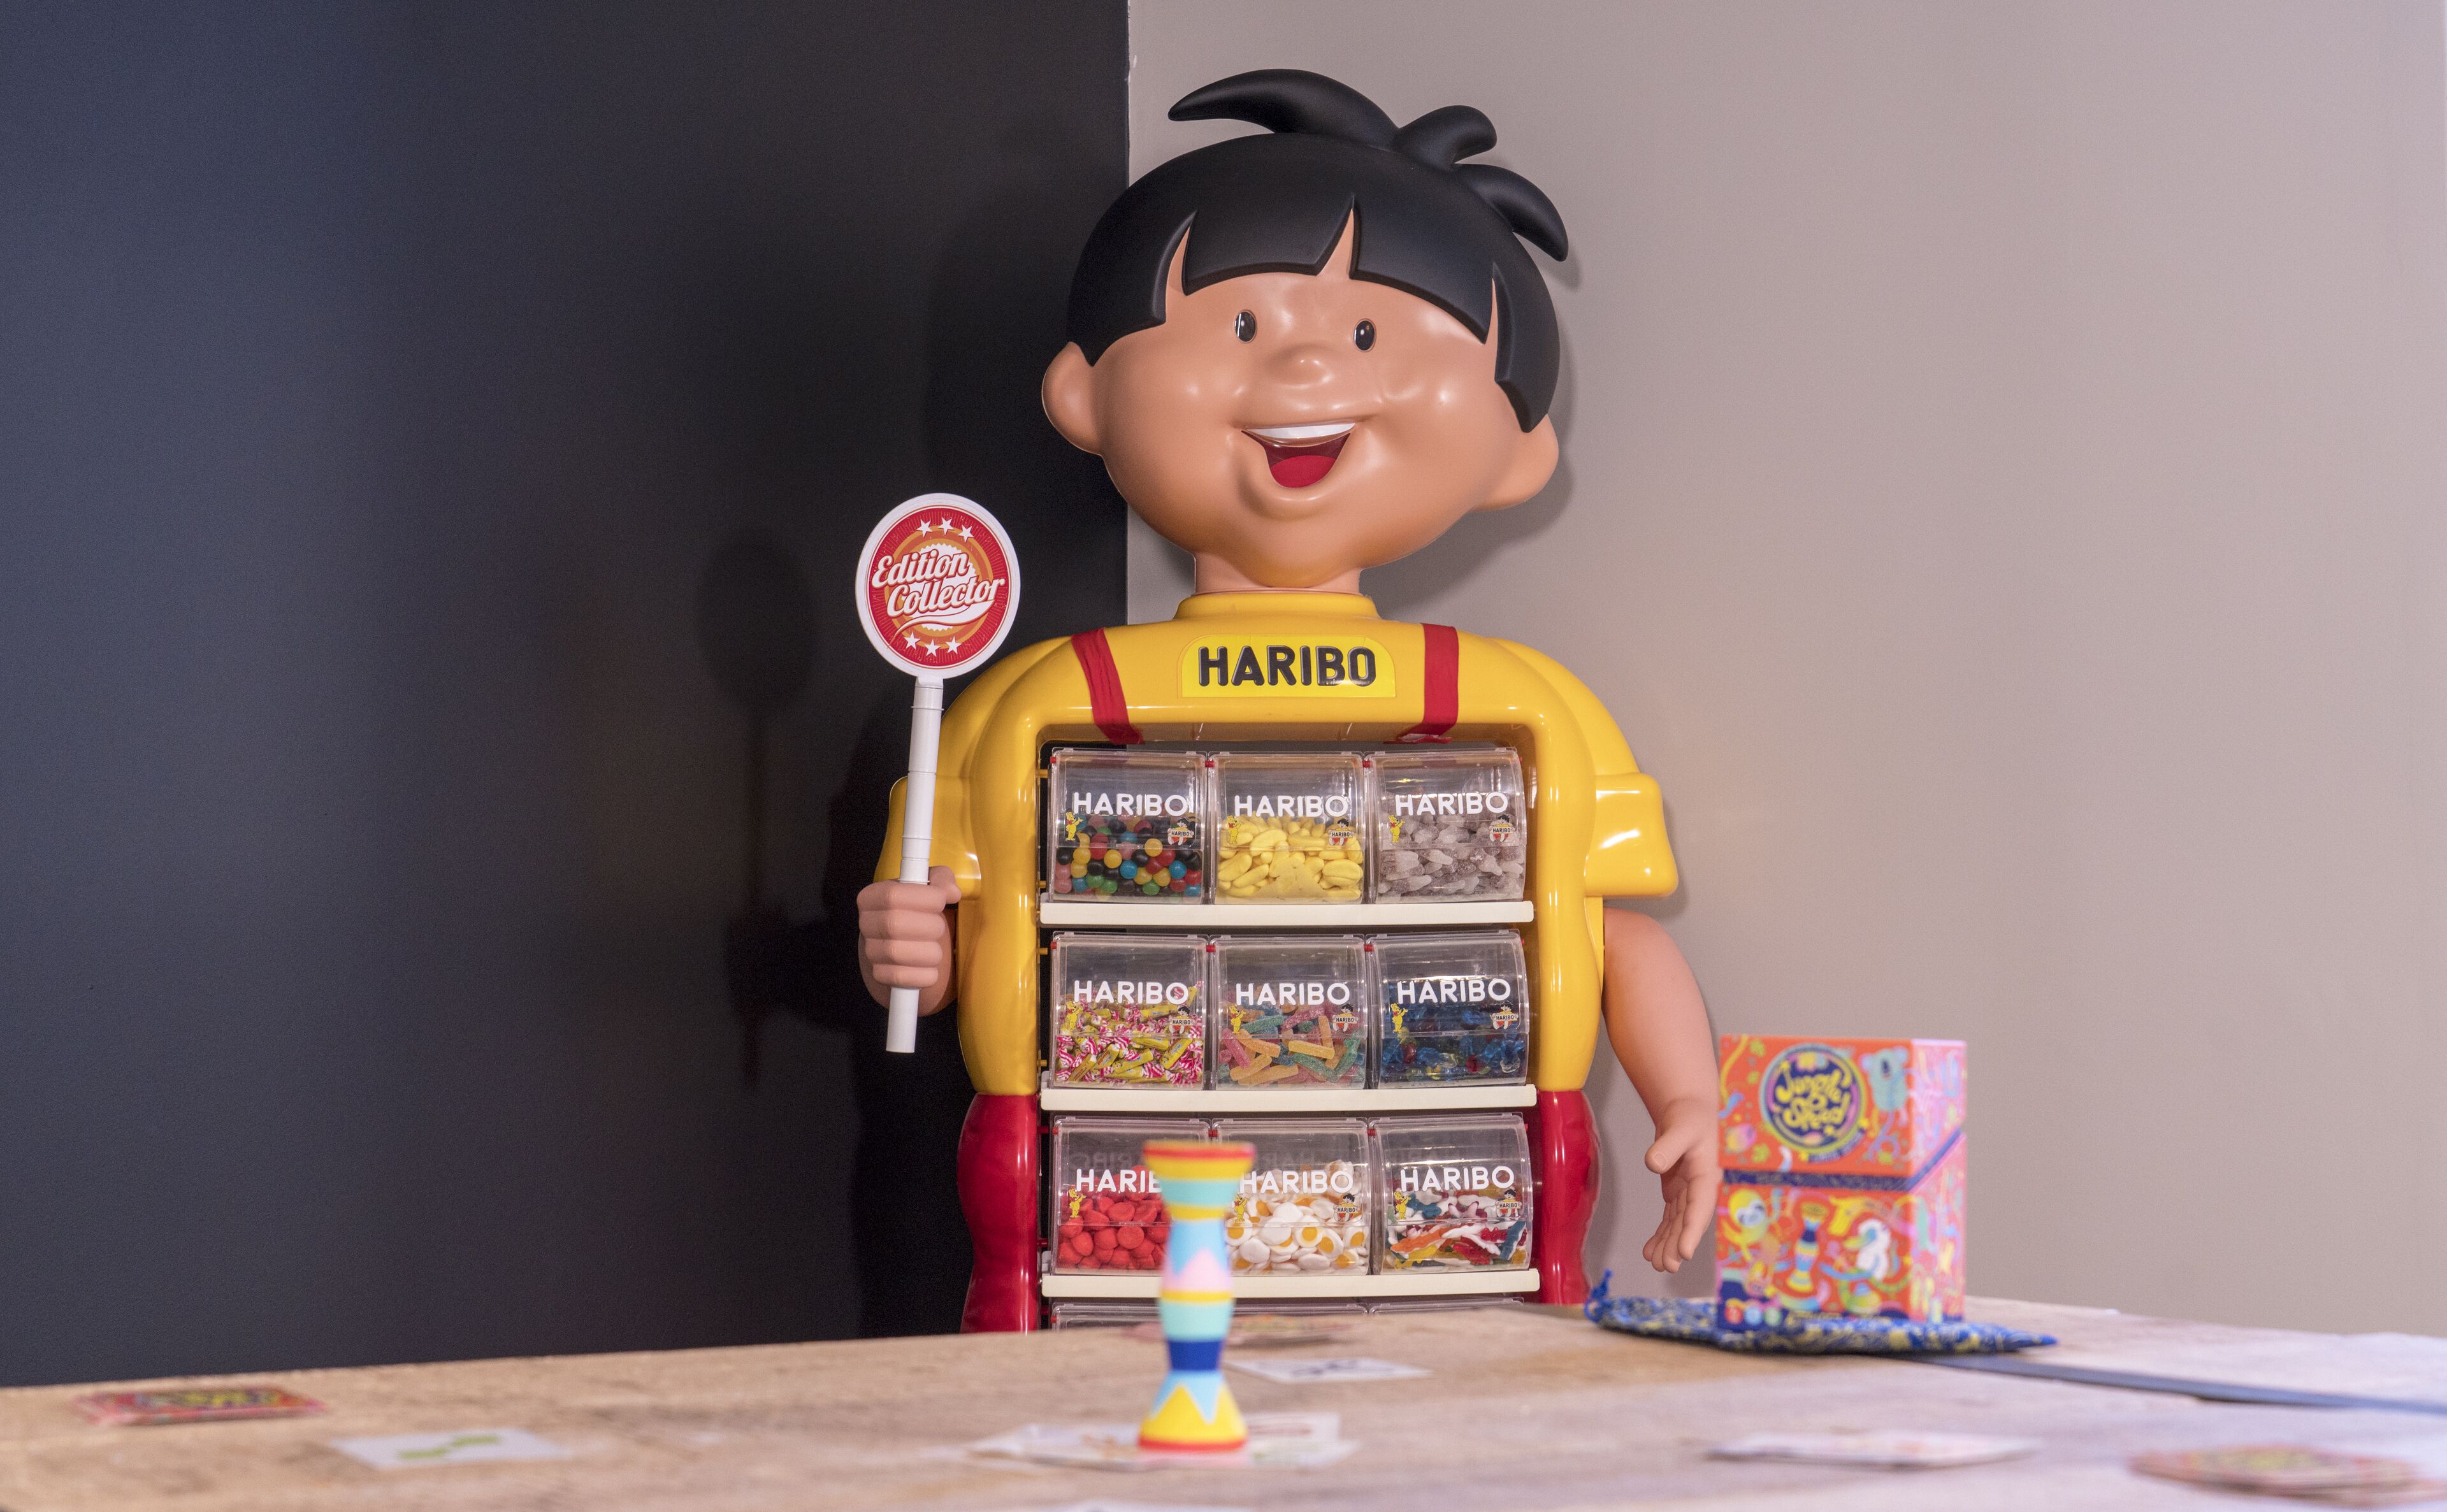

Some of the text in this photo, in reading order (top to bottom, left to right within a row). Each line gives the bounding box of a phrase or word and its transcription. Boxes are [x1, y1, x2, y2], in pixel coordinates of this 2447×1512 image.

[872, 549, 969, 589] Edition
[886, 575, 1006, 617] Collector
[1198, 645, 1376, 686] HARIBO
[1073, 792, 1188, 816] HARIBO
[1234, 795, 1348, 817] HARIBO
[1395, 792, 1508, 816] HARIBO
[1074, 980, 1188, 1005] HARIBO
[1236, 983, 1350, 1005] HARIBO
[1397, 979, 1511, 1004] HARIBO
[1240, 1170, 1353, 1194] HARIBO
[1400, 1166, 1514, 1192] HARIBO
